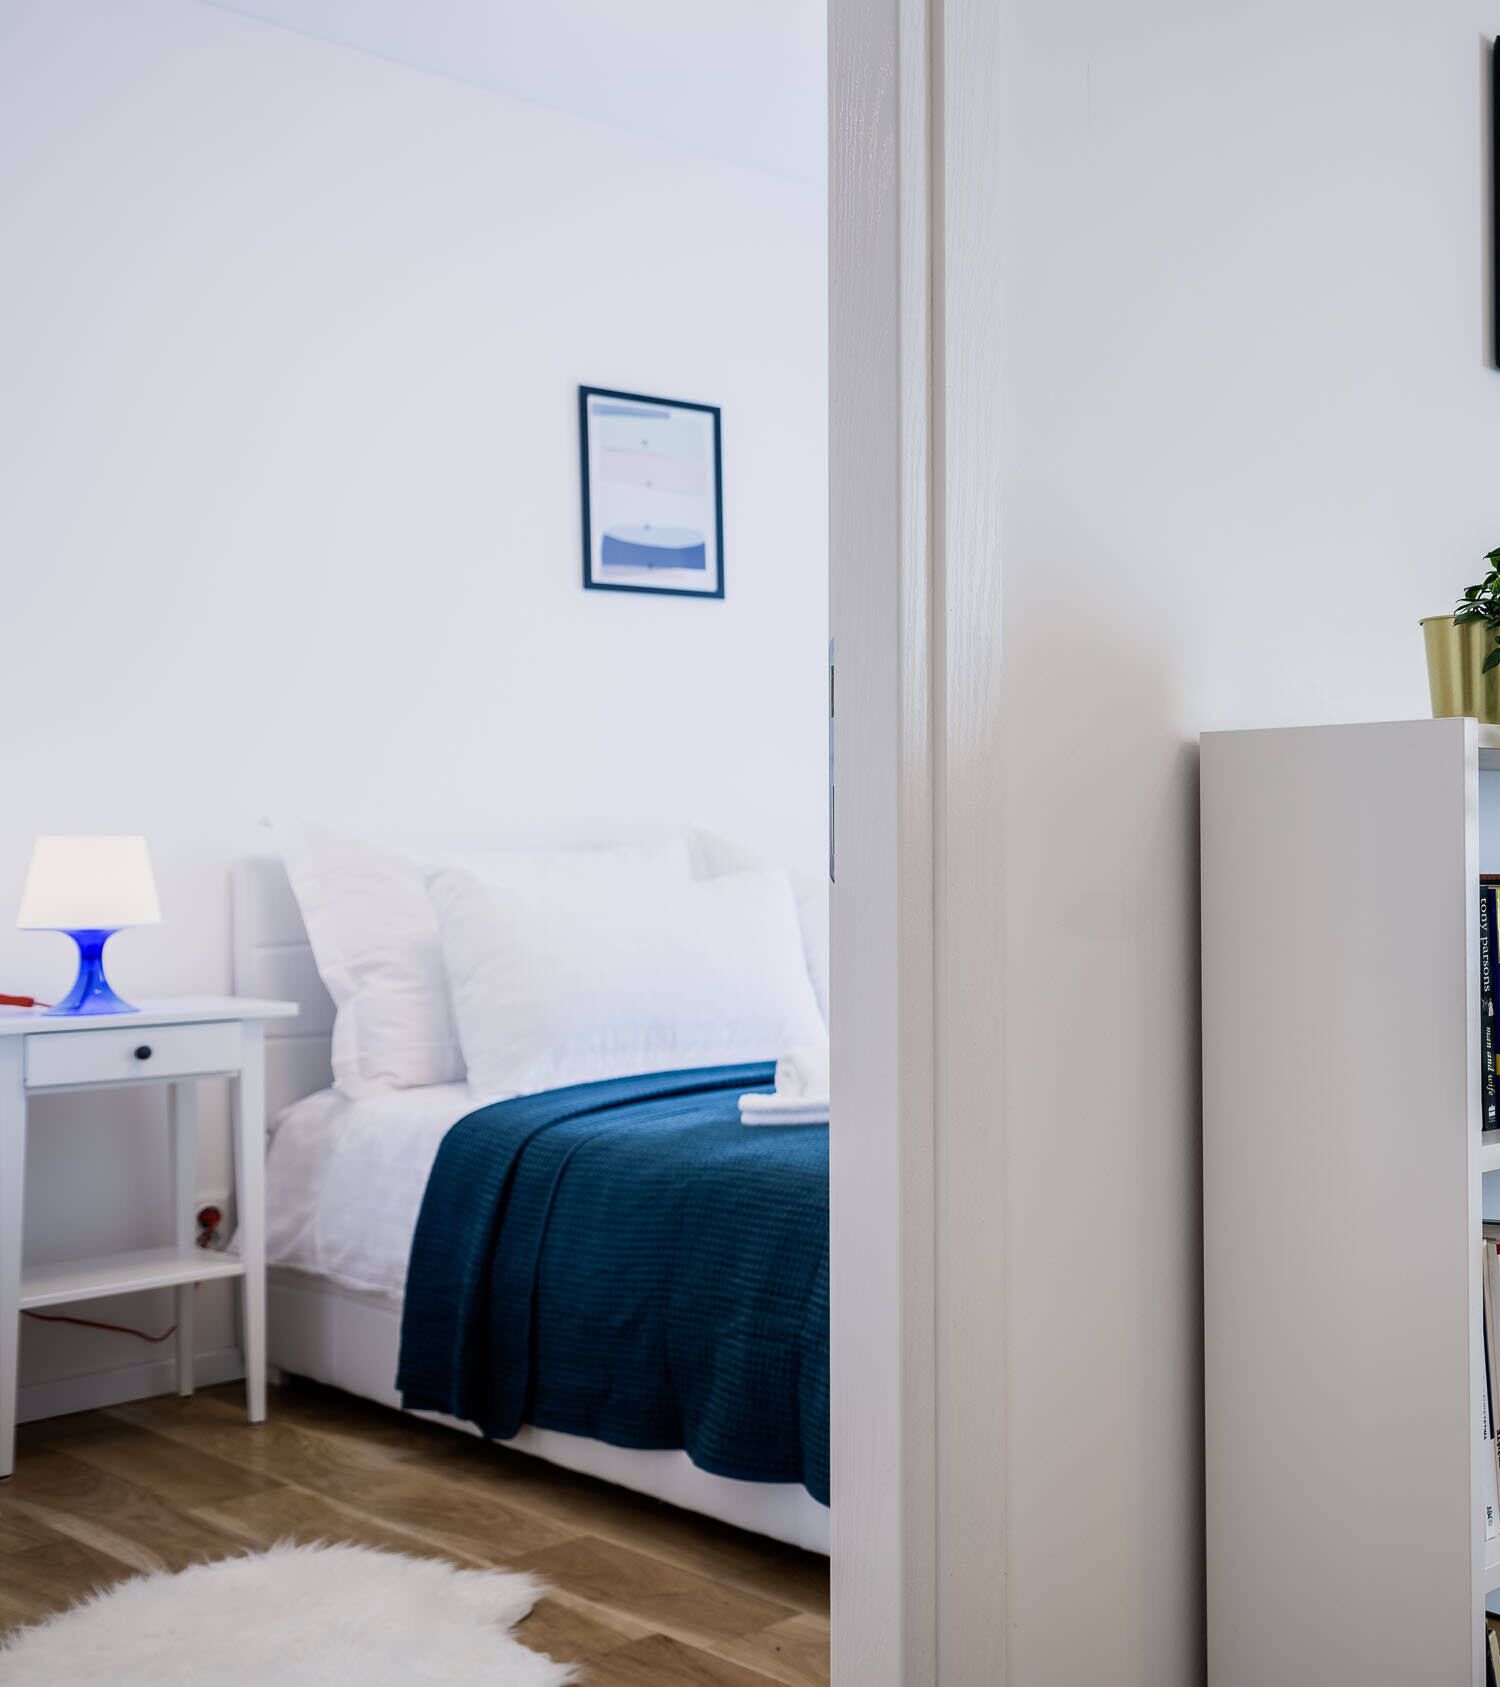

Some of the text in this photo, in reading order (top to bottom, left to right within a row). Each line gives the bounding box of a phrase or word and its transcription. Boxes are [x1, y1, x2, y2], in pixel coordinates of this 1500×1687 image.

[1480, 898, 1491, 992] tony parsons
[1485, 1026, 1496, 1096] man and wife
